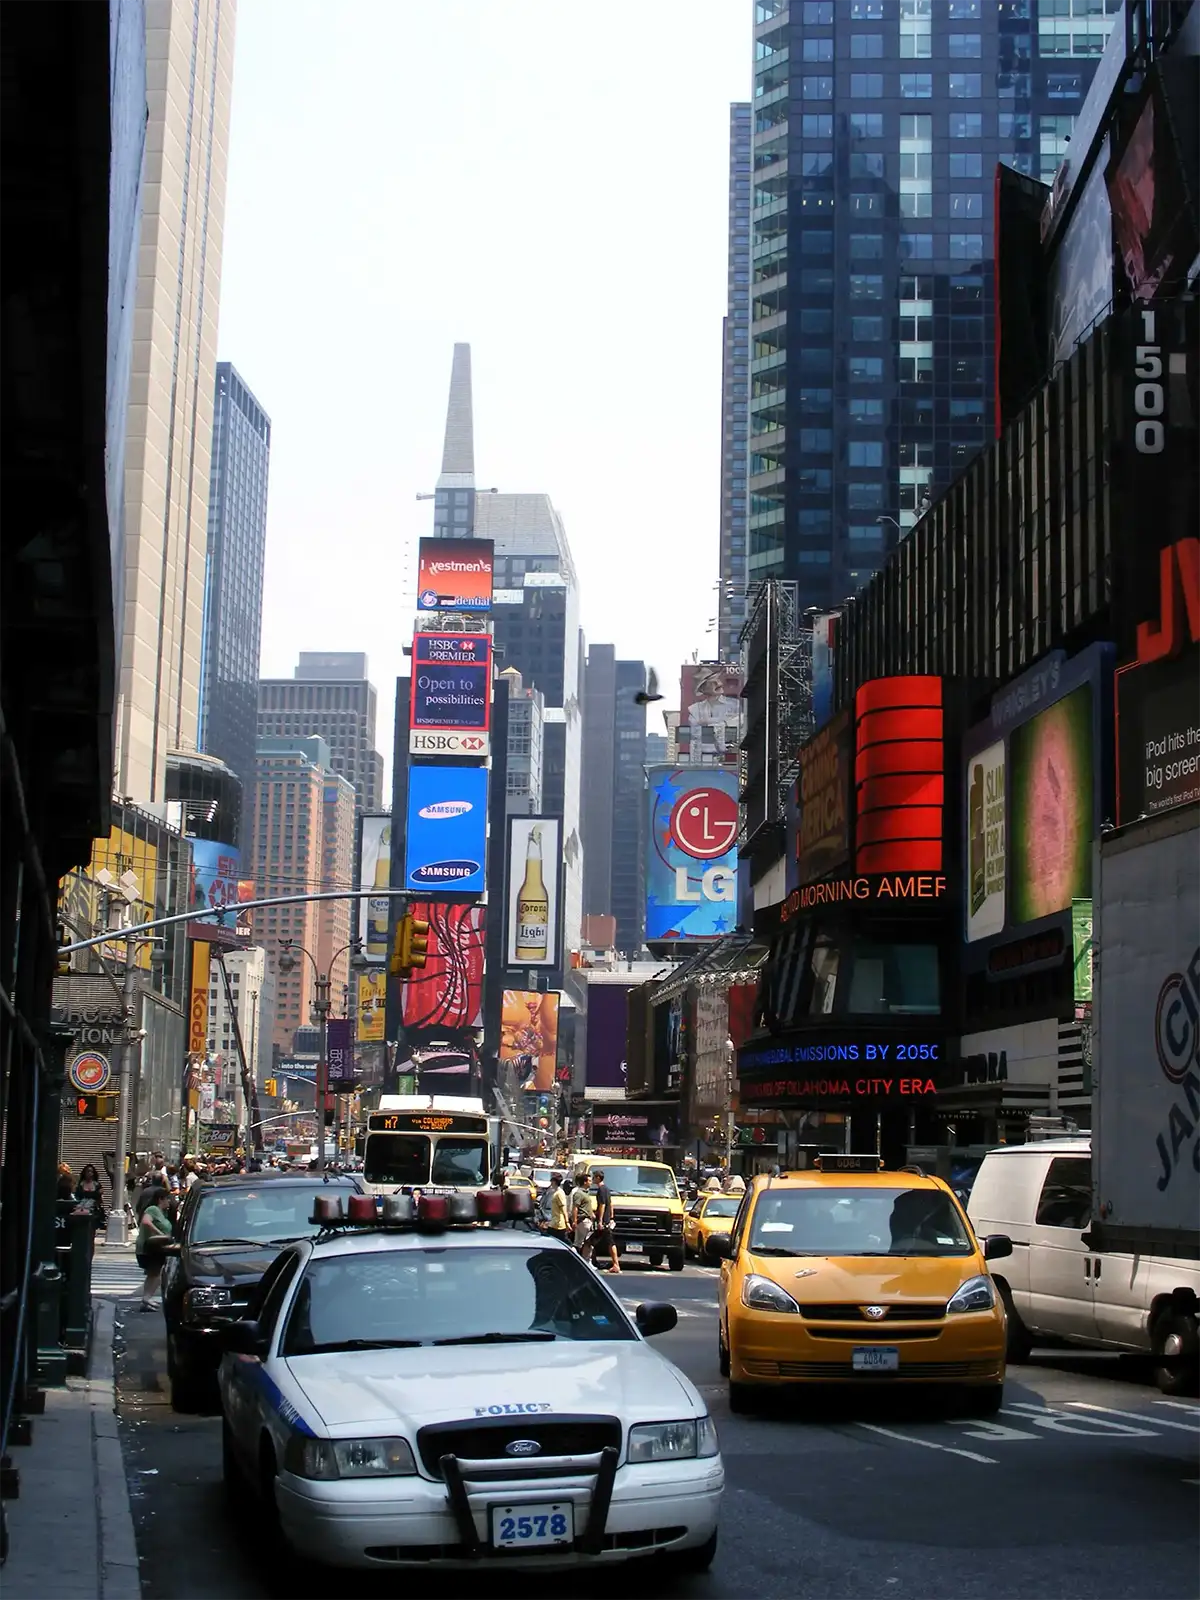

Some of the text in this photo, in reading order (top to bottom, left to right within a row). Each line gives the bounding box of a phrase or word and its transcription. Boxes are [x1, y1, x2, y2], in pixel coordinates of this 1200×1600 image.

[1134, 310, 1165, 454] 1500
[428, 639, 459, 651] HSBC
[429, 651, 476, 661] PREMIER
[418, 676, 474, 692] Open to
[425, 694, 485, 706] possibilities
[414, 735, 459, 750] HSBC
[1145, 726, 1200, 760] iPod hits the
[1146, 764, 1163, 790] big
[426, 805, 467, 814] SAMSUNG
[420, 866, 471, 877] SAMSUNG
[675, 866, 735, 902] LG
[801, 877, 870, 908] MORNING
[519, 902, 547, 914] Corona
[519, 924, 545, 939] Light
[795, 1044, 860, 1063] EMISSIONS
[865, 1044, 891, 1060] BY
[855, 1078, 894, 1095] CITY
[899, 1078, 937, 1095] ERA
[384, 1116, 399, 1129] M7
[474, 1402, 553, 1416] POLICE
[513, 1442, 533, 1453] Ford
[499, 1513, 568, 1541] 2578
